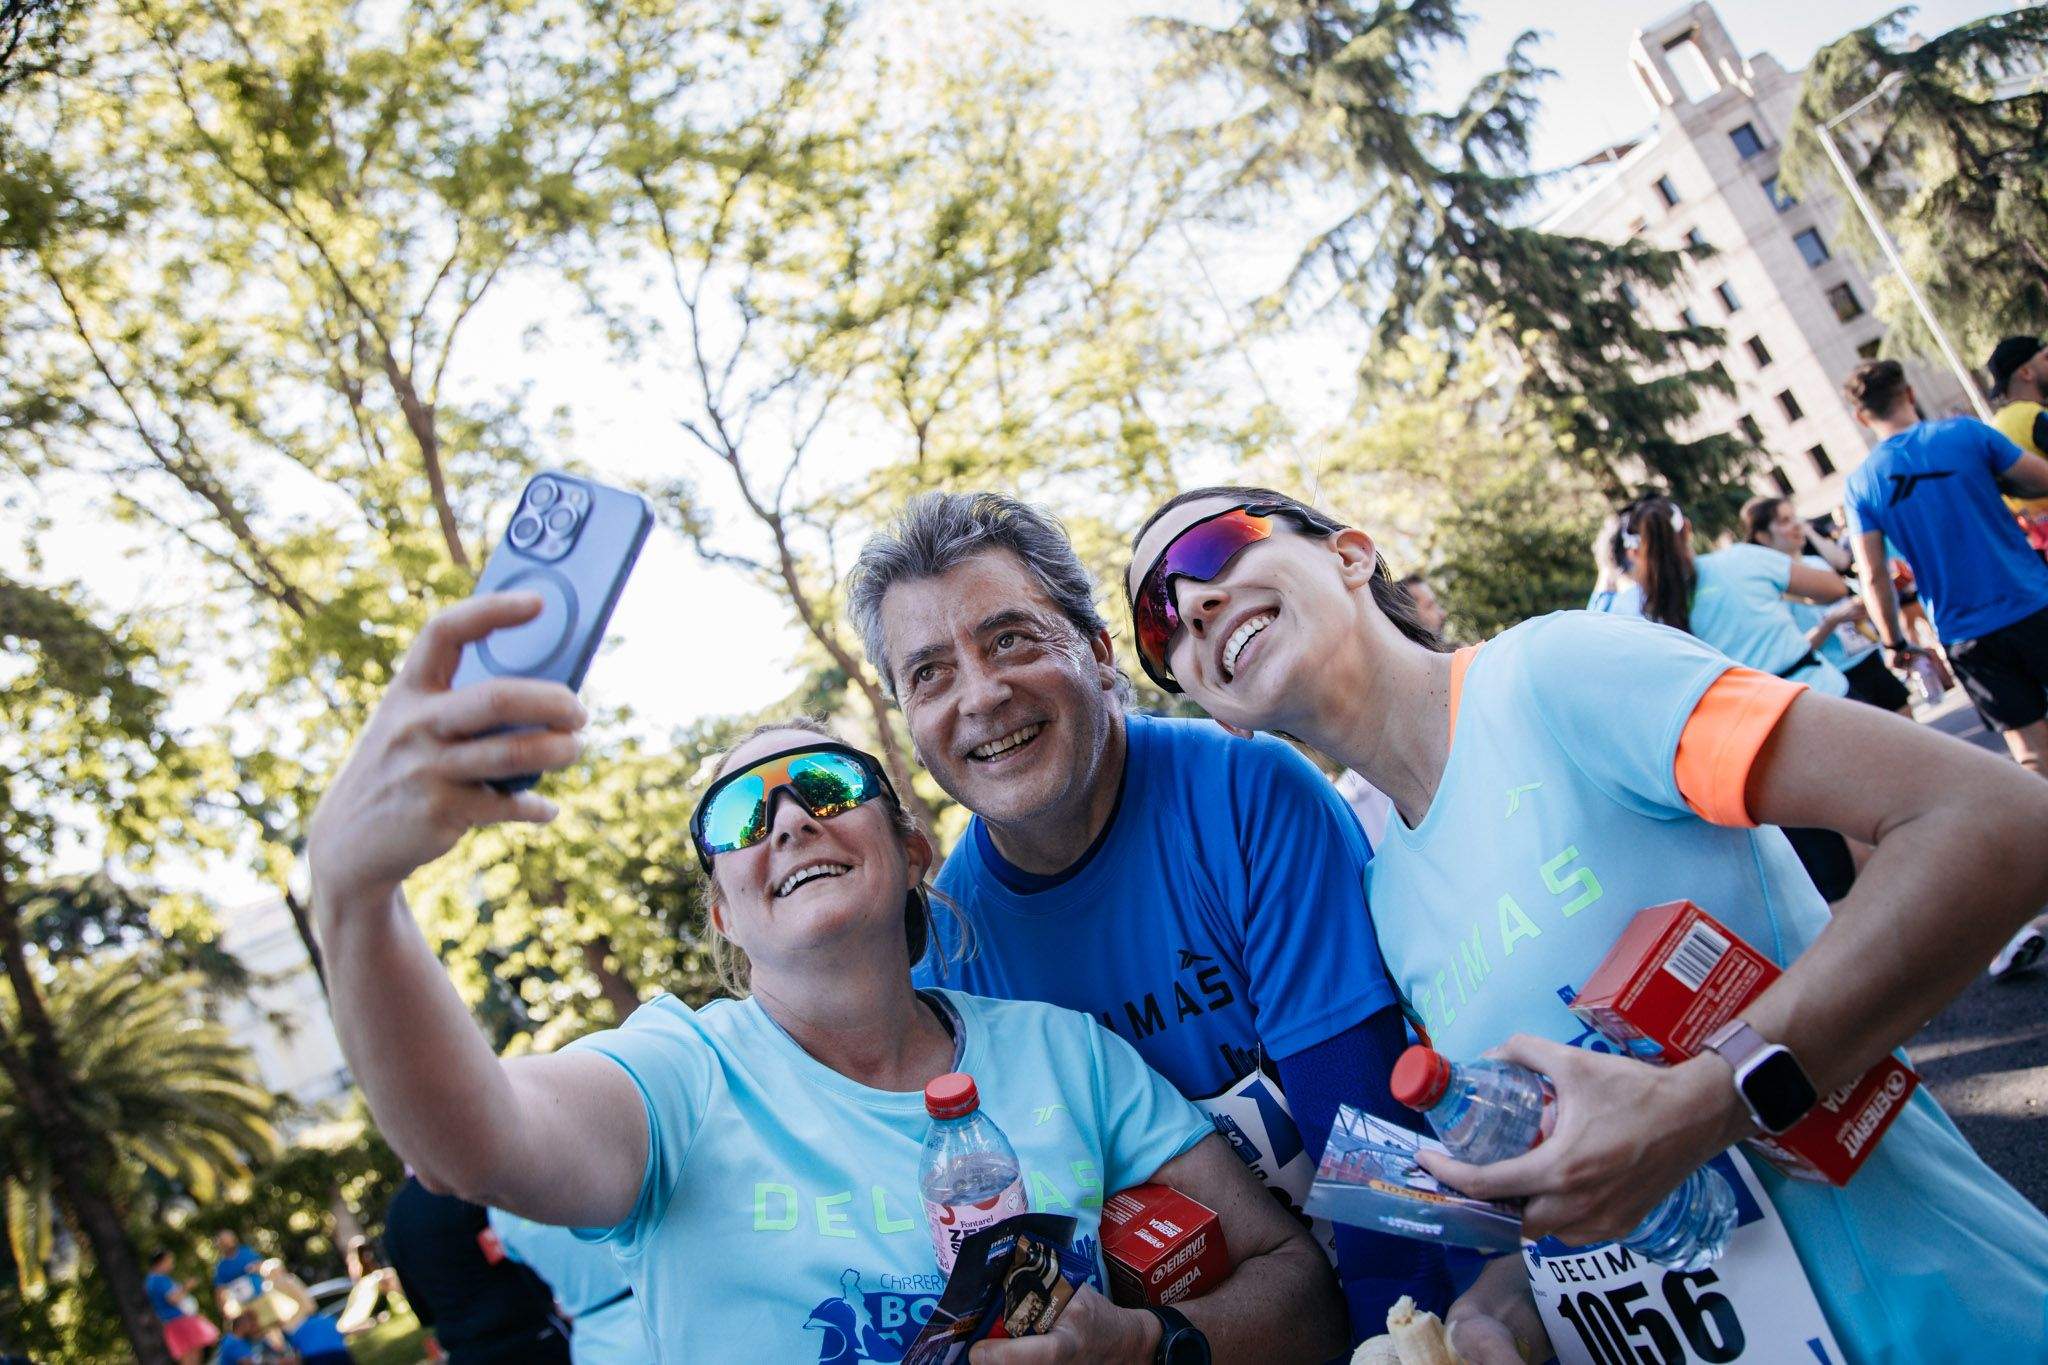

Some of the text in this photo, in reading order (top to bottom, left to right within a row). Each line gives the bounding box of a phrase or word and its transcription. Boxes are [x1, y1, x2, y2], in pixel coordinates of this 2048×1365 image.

[1842, 1090, 1894, 1160] ENERVIT
[960, 1214, 994, 1229] Fontarel
[1166, 1232, 1206, 1274] ENERVIT
[1547, 1246, 1652, 1283] DECIM
[1160, 1265, 1202, 1306] BEBIDA
[1038, 1296, 1058, 1331] CHOCOLATE
[1557, 1267, 1745, 1365] 1056
